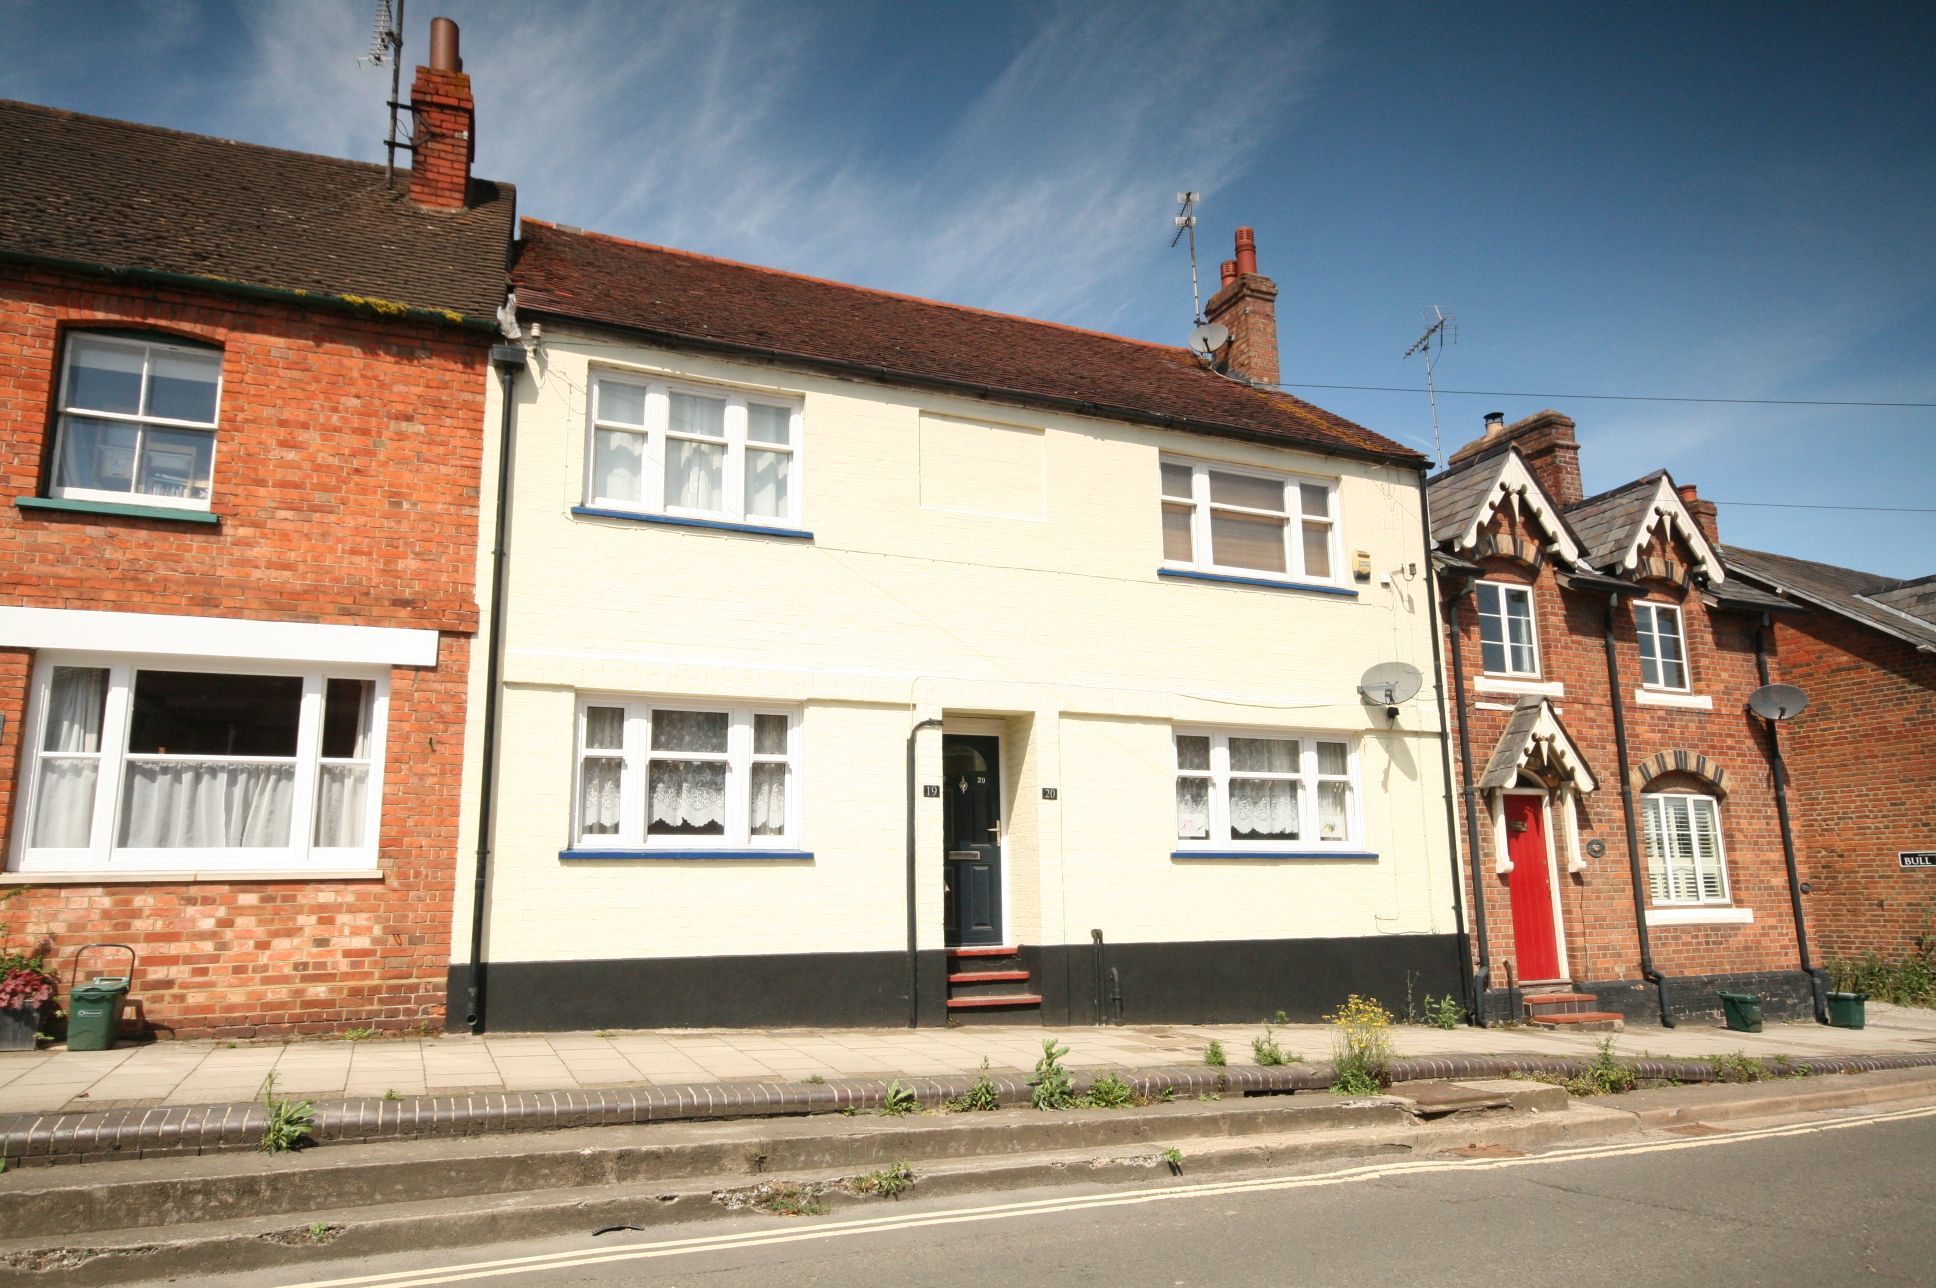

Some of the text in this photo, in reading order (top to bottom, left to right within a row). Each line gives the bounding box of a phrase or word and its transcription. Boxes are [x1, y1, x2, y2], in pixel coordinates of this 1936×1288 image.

[977, 776, 986, 784] 20
[927, 785, 938, 797] 19
[1044, 788, 1056, 799] 20
[1903, 856, 1932, 865] BULL
